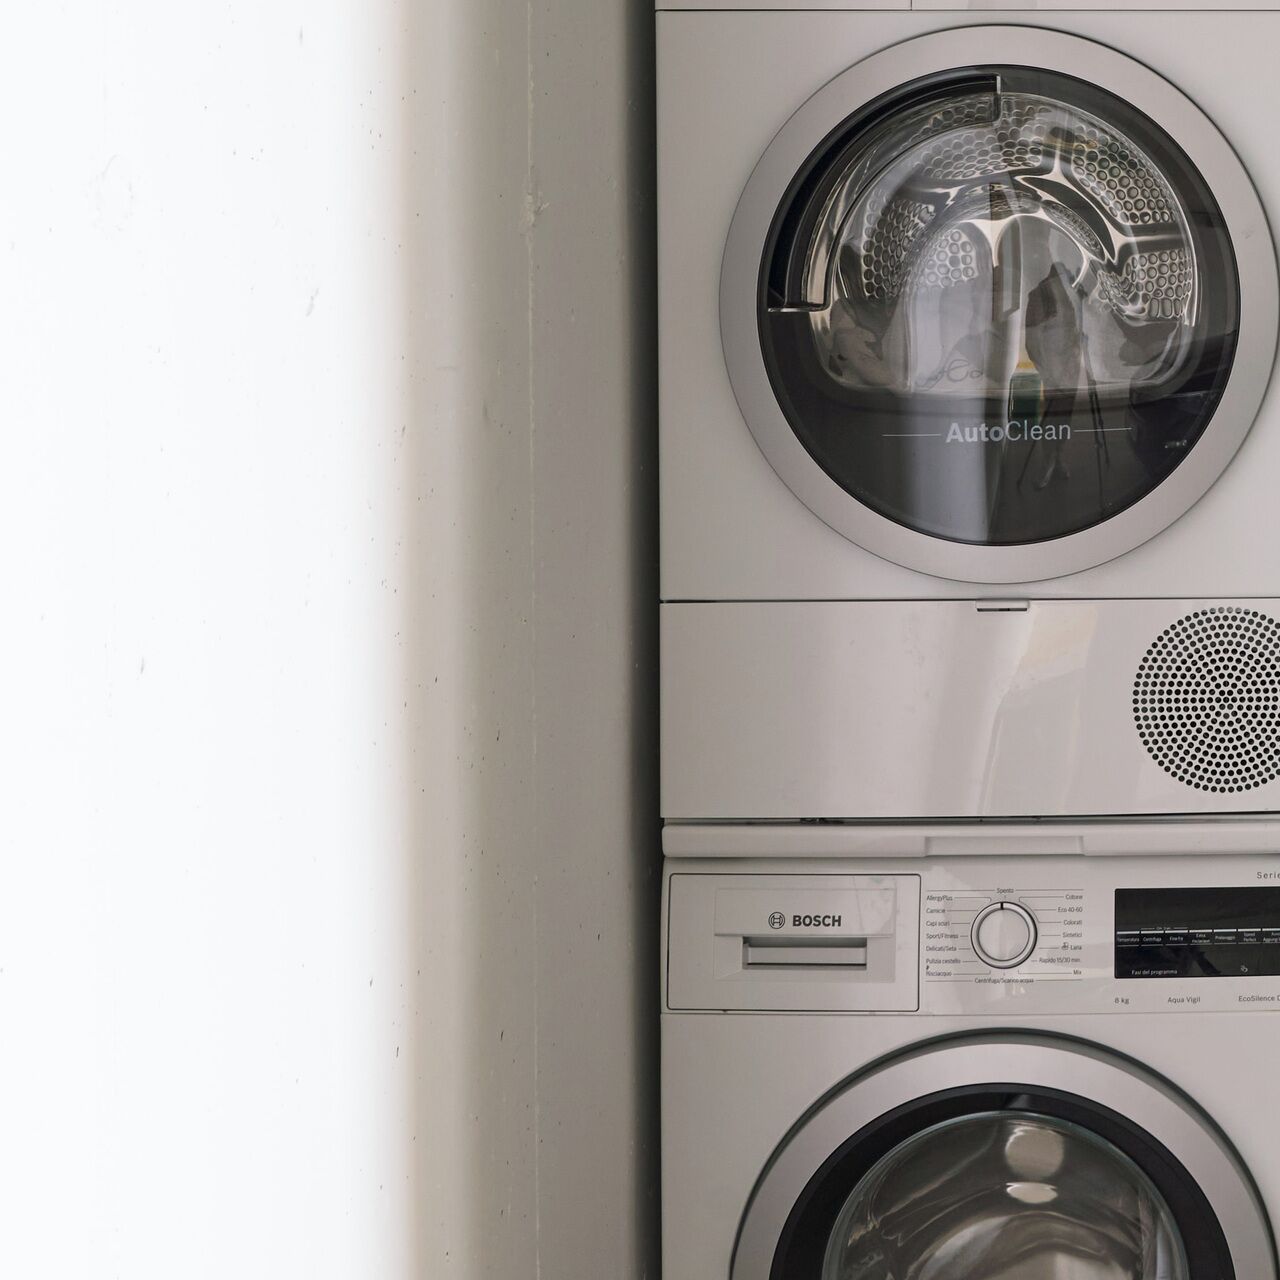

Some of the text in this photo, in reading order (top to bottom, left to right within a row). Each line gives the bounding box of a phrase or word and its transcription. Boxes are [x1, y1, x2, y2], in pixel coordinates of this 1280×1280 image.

[945, 420, 1071, 442] AutoClean
[792, 914, 841, 927] BOSCH
[1121, 997, 1130, 1005] kg
[1167, 996, 1201, 1004] Aqua Vigil
